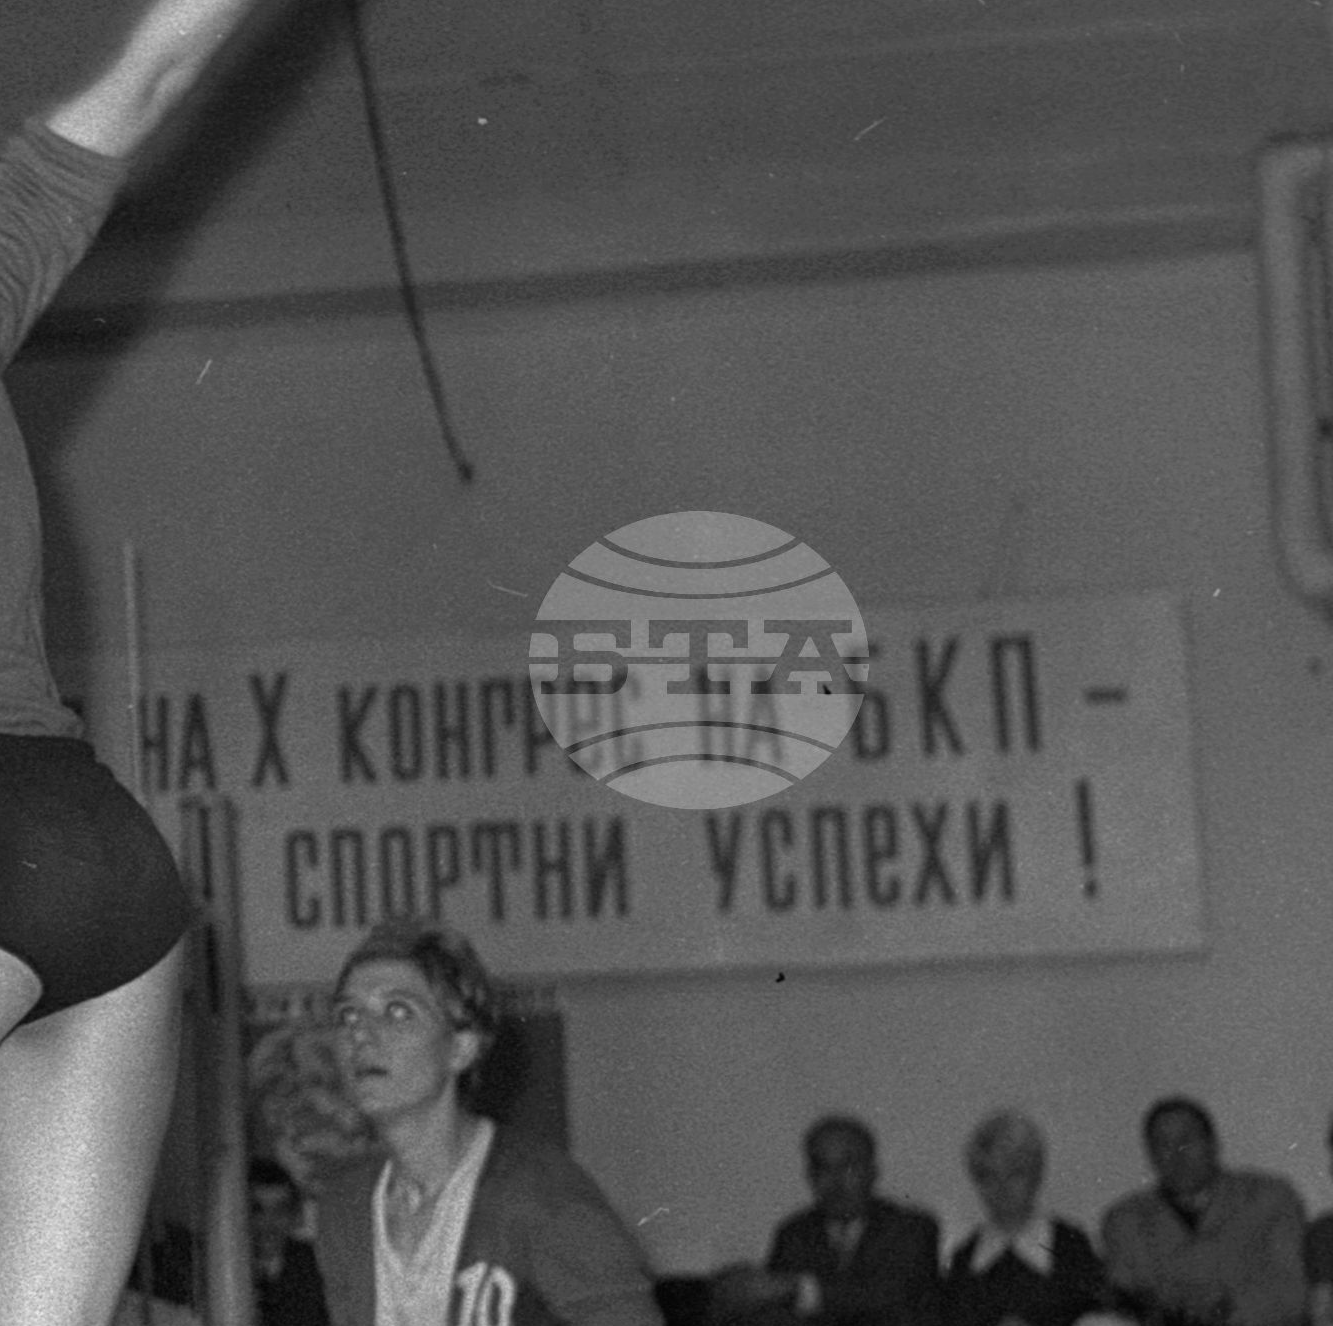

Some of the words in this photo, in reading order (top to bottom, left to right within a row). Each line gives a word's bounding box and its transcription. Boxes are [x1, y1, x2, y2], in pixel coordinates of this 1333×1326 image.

[137, 691, 217, 794] НА
[843, 632, 1042, 760] БКП
[284, 813, 632, 930] СПОРТНИ
